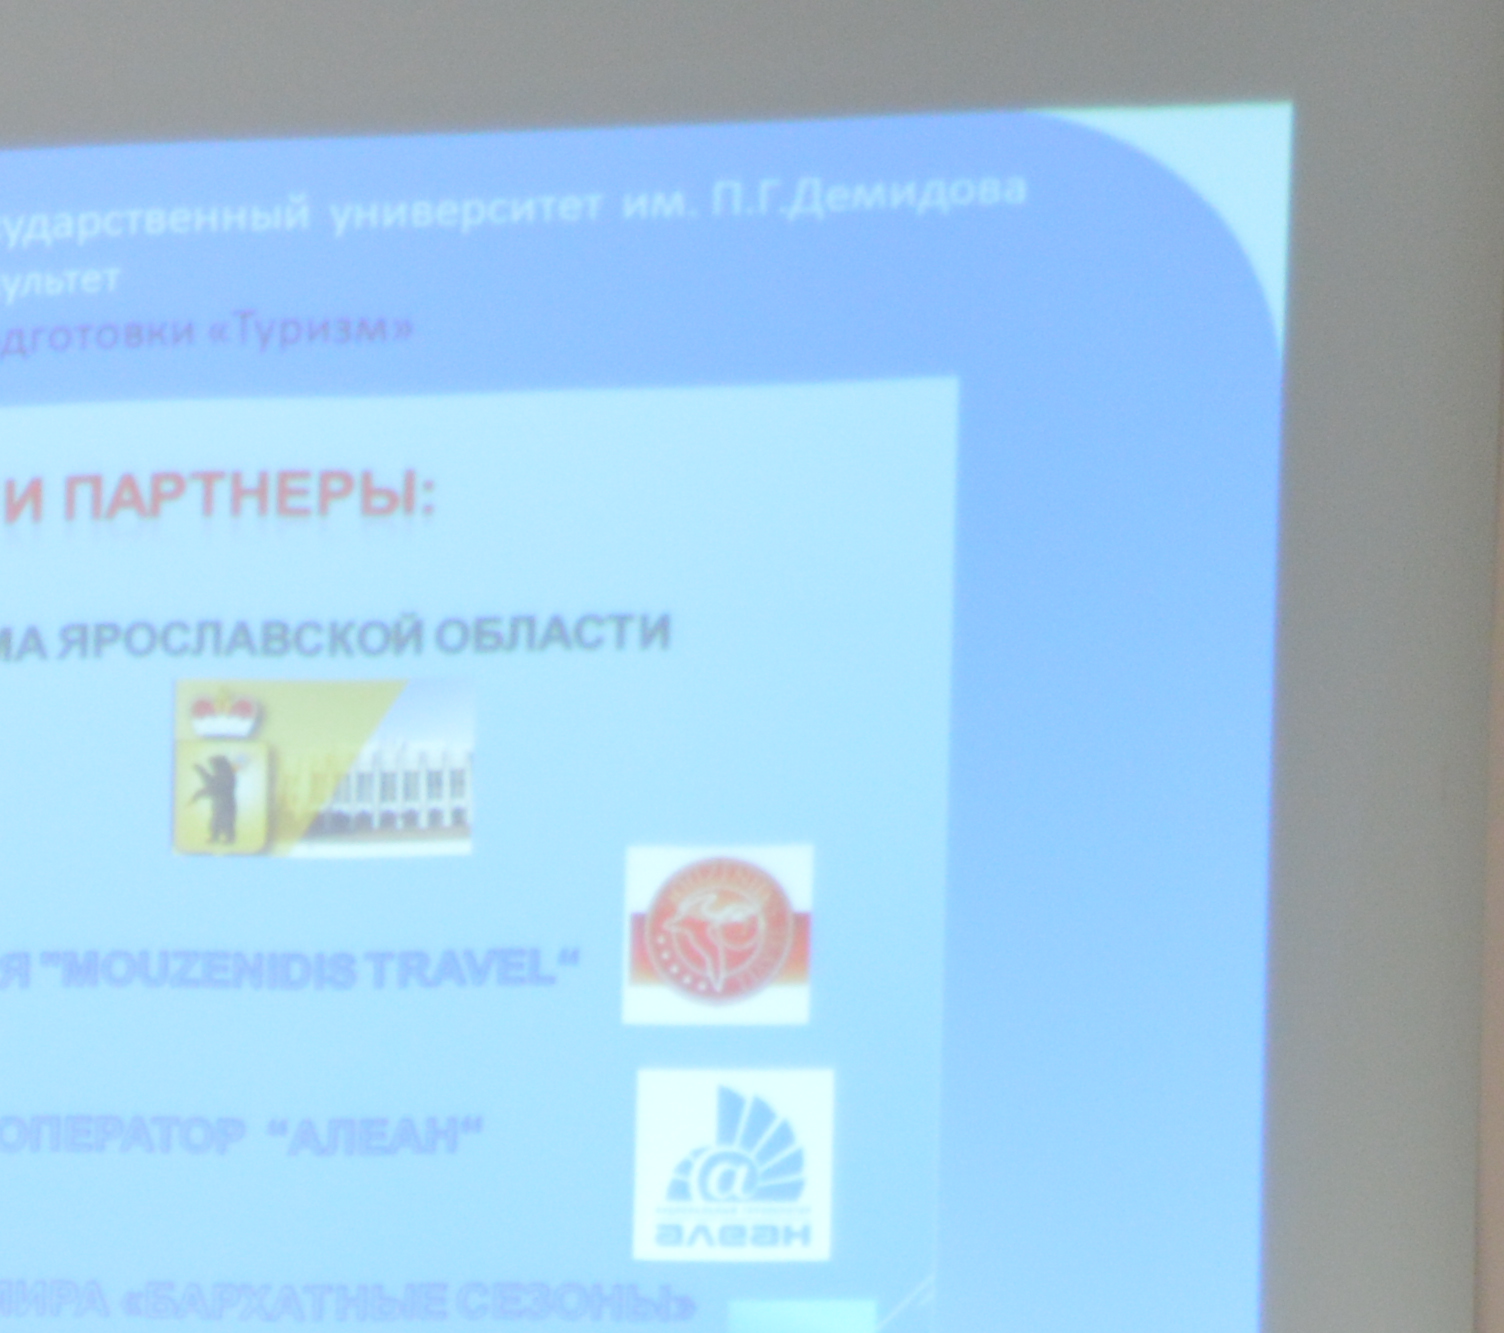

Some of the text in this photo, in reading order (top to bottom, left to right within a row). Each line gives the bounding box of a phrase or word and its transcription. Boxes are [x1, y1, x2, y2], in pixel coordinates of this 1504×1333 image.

[329, 191, 604, 238] университет
[622, 188, 698, 220] им.
[711, 174, 1028, 224] П.Г.Демидова
[208, 310, 415, 354] «Туризм»
[65, 469, 436, 521] ПАРТНЕРЫ:
[57, 613, 425, 660] ЯРОСЛАВСКОЙ
[435, 611, 673, 656] ОБЛАСТИ
